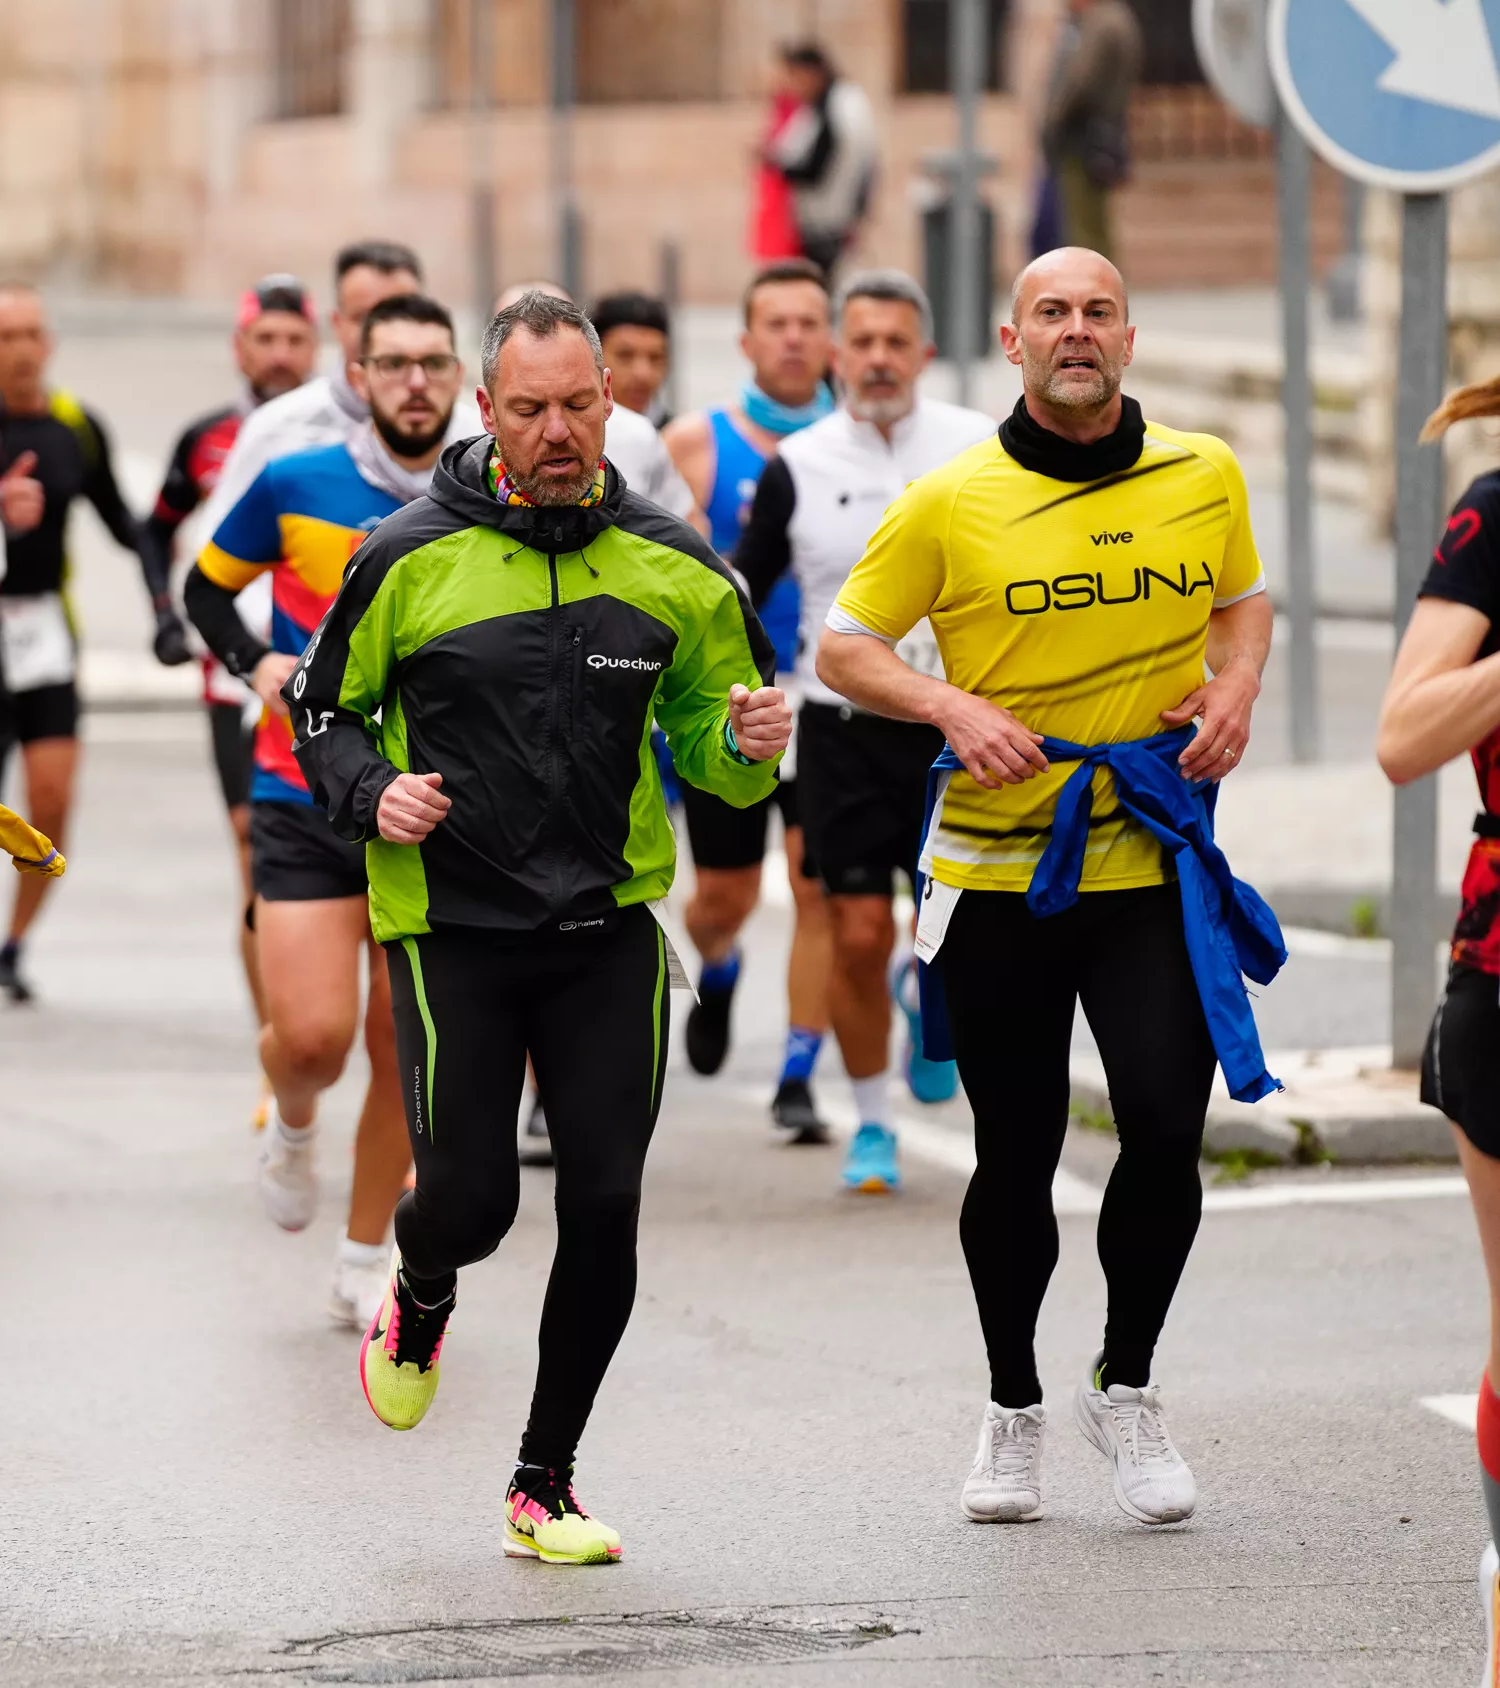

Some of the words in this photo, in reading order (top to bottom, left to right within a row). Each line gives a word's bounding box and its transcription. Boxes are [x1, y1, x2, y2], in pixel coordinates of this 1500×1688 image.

[1090, 531, 1134, 546] vive
[1005, 561, 1215, 615] OSUNA
[586, 654, 662, 671] Quechua
[414, 1066, 423, 1134] Quechua
